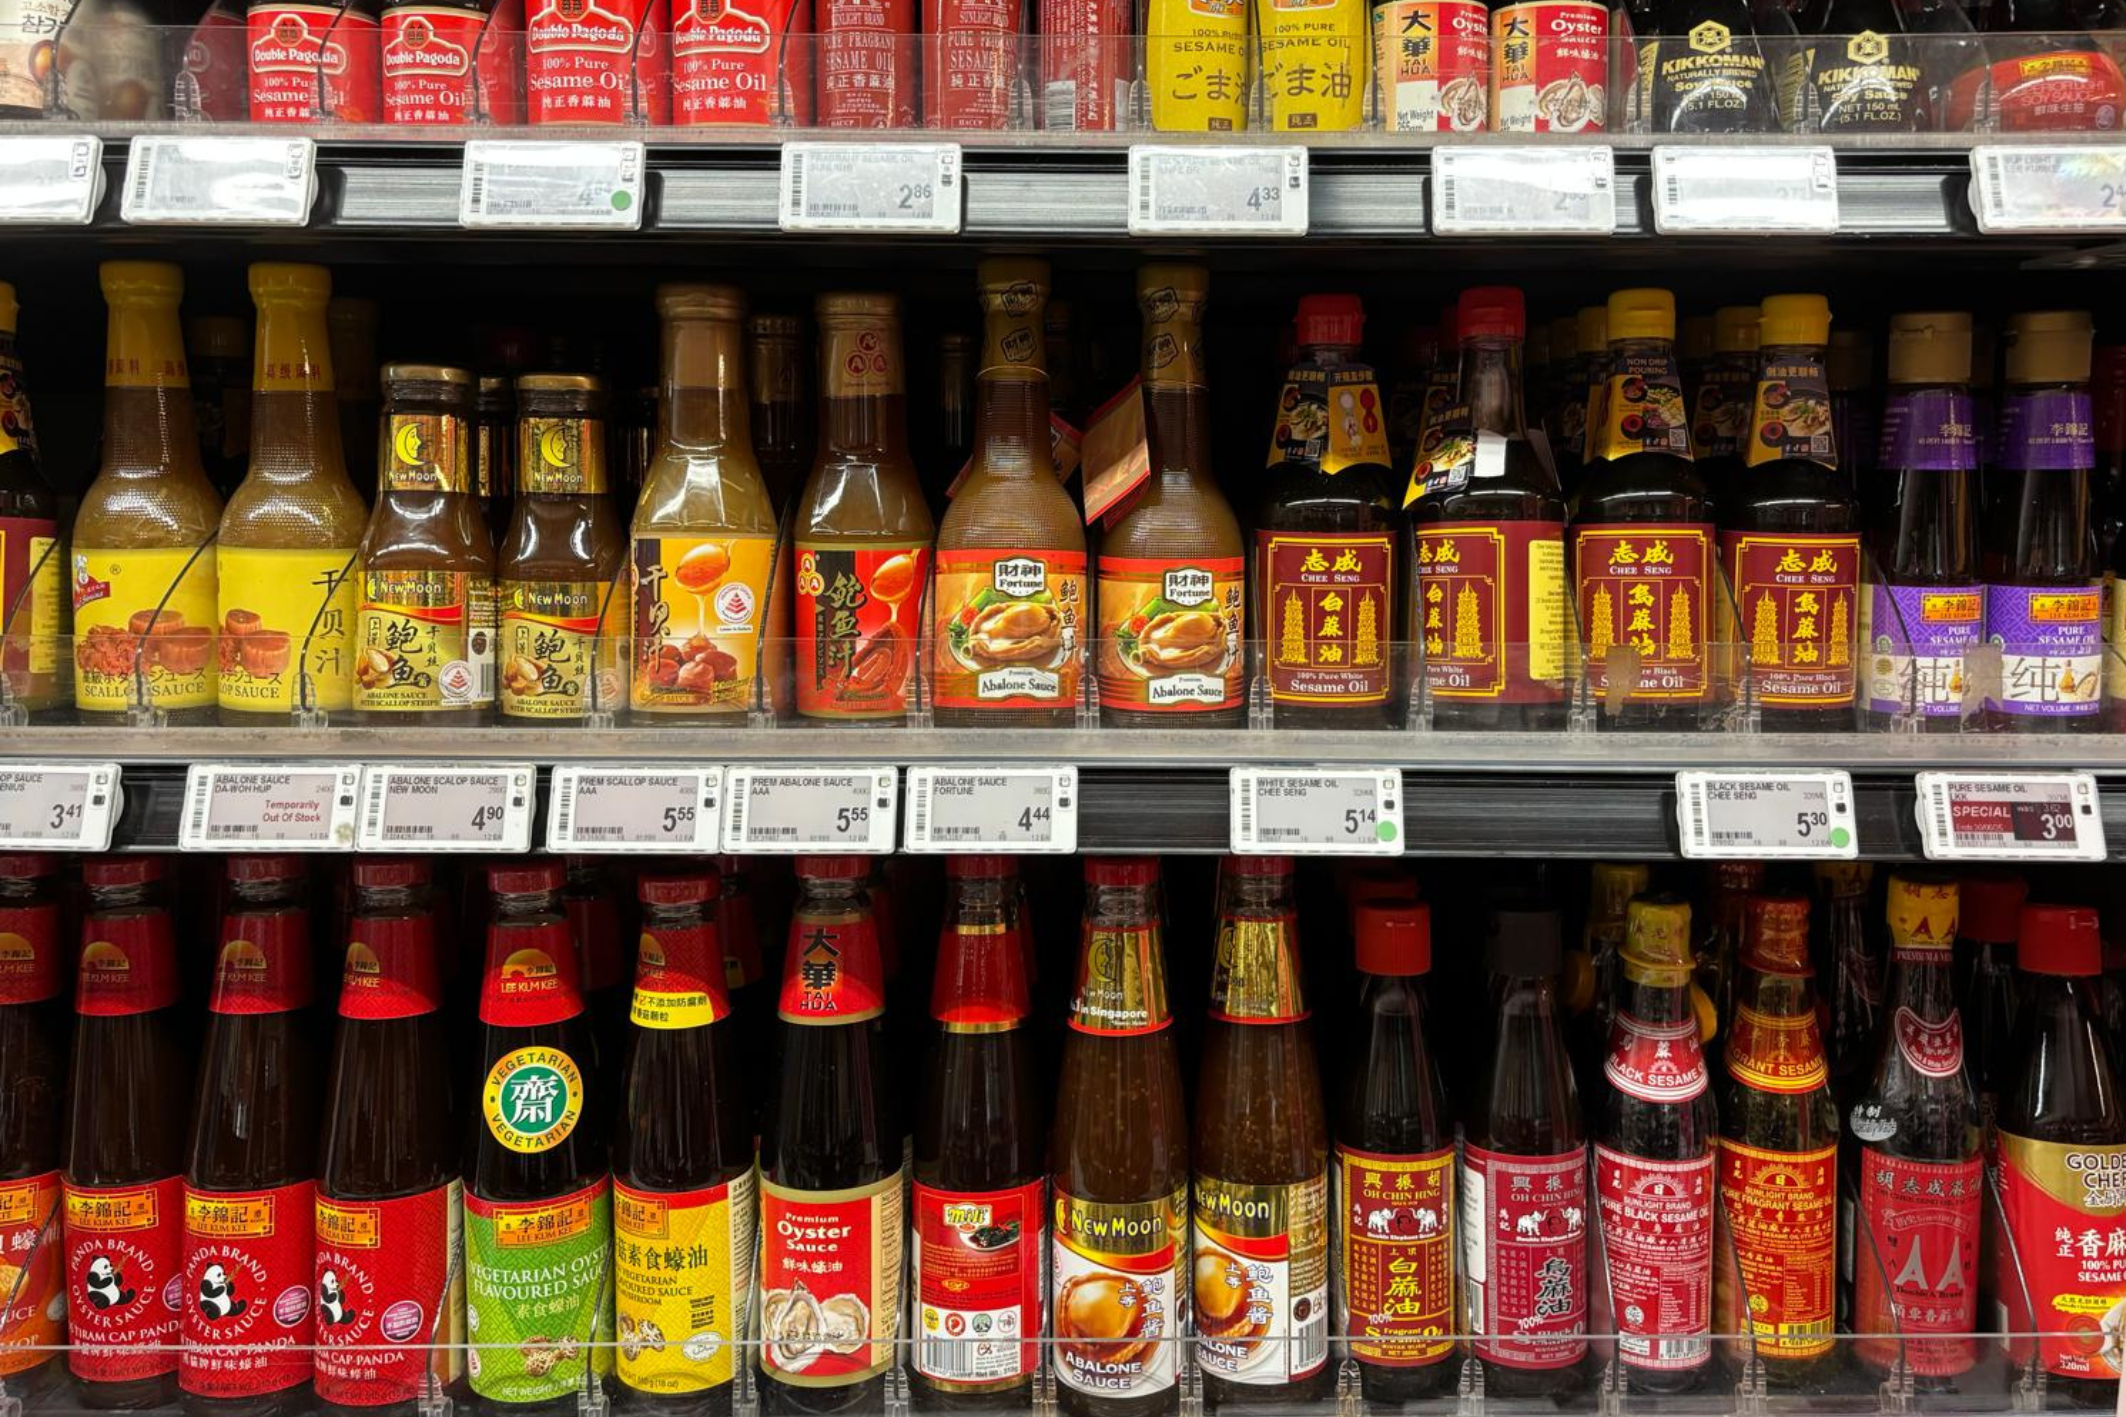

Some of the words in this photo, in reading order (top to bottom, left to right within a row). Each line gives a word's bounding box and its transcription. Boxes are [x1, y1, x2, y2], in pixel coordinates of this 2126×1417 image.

[532, 26, 569, 41] Double
[572, 24, 624, 41] Pagoda
[675, 26, 707, 43] Double
[709, 25, 761, 42] Pagoda
[1274, 23, 1301, 34] 100%
[1303, 22, 1336, 33] PURE
[1550, 19, 1603, 36] Oyster
[1174, 41, 1239, 54] SESAME
[1262, 38, 1322, 52] SESAME
[1327, 37, 1351, 49] OIL
[254, 49, 287, 62] Double
[386, 53, 414, 66] Double
[415, 52, 460, 65] Pagoda
[542, 58, 571, 70] 100%
[575, 57, 608, 69] Pure
[684, 60, 708, 74] 100%
[1403, 59, 1428, 67] TAI
[1661, 54, 1765, 75] KIKKOMAN
[1400, 66, 1432, 77] HUA
[418, 80, 447, 90] Pure
[531, 74, 594, 92] Sesame
[673, 75, 730, 93] Sesame
[736, 72, 767, 92] Oil
[254, 91, 308, 103] Sesame
[385, 94, 435, 105] Sesame
[439, 91, 466, 105] Oil
[1609, 565, 1638, 575] CHEE
[1644, 565, 1672, 575] SENG
[998, 578, 1043, 589] Fortune
[1334, 573, 1361, 583] SENG
[1775, 573, 1805, 584] CHEE
[1810, 574, 1836, 584] SENG
[1169, 588, 1211, 599] Fortune
[1318, 672, 1338, 680] Pure
[1653, 667, 1678, 676] Black
[982, 678, 1027, 692] Abalone
[1028, 679, 1058, 693] Sauce
[1290, 679, 1346, 693] Sesame
[1348, 680, 1369, 693] Oil
[1449, 673, 1470, 688] Oil
[1662, 675, 1685, 689] Oil
[1761, 680, 1819, 694] Sesame
[1822, 681, 1842, 694] Oil
[234, 686, 280, 699] SAUCE
[1152, 686, 1195, 699] Abalone
[1197, 686, 1223, 699] Sauce
[14, 774, 43, 783] SAUCE
[215, 775, 251, 785] ABALONE
[256, 775, 291, 785] SAUCE
[389, 776, 431, 786] ABALONE
[433, 776, 468, 786] SCALOP
[470, 776, 499, 786] SAUCE
[579, 777, 605, 786] PREM
[606, 777, 646, 786] SCALLOP
[648, 777, 678, 786] SAUCE
[779, 778, 822, 787] ABALONE
[823, 778, 854, 787] SAUCE
[934, 777, 976, 787] ABALONE
[978, 777, 1008, 787] SAUCE
[1257, 778, 1286, 788] WHITE
[1288, 778, 1322, 788] SESAME
[1324, 778, 1339, 788] OIL
[389, 786, 410, 795] NEW
[411, 786, 438, 795] MOON
[578, 786, 598, 795] AAA
[752, 787, 770, 796] AAA
[934, 786, 975, 796] FORTUNE
[1257, 787, 1282, 797] CHEE
[1284, 787, 1307, 797] SENG
[1706, 782, 1736, 792] BLACK
[1738, 782, 1775, 792] SESAME
[1776, 783, 1791, 792] OIL
[1948, 784, 1973, 793] PURE
[1975, 783, 2012, 793] SESAME
[2013, 784, 2028, 793] OIL
[1707, 791, 1732, 801] CHEE
[1734, 791, 1758, 801] SENG
[265, 800, 320, 812] Temporarily
[1952, 805, 2012, 818] SPECIAL
[262, 813, 281, 823] Out
[282, 813, 295, 823] Of
[295, 813, 321, 823] Stock
[501, 980, 517, 993] LEE
[518, 980, 540, 993] KUM
[541, 978, 558, 992] KEE
[804, 992, 832, 1001] TAI
[800, 1000, 837, 1011] HUA
[1090, 1007, 1148, 1020] Singapore
[491, 1052, 577, 1087] VEGETARIAN
[1647, 1067, 1698, 1087] SESAME
[491, 1108, 577, 1148] VEGETARIAN
[1363, 1188, 1380, 1199] OH
[1382, 1191, 1412, 1201] CHIN
[1511, 1192, 1530, 1203] OH
[1532, 1192, 1561, 1204] CHIN
[785, 1212, 840, 1224] Premium
[1624, 1206, 1659, 1223] BLACK
[1661, 1211, 1699, 1223] SESAME
[776, 1219, 852, 1241] Oyster
[786, 1239, 839, 1253] Sauce
[72, 1239, 104, 1271] PANDA
[107, 1239, 155, 1273] BRAND
[186, 1246, 218, 1279] PANDA
[221, 1245, 267, 1283] BRAND
[2081, 1260, 2111, 1271] 100%
[334, 1252, 375, 1296] BRAND
[471, 1260, 566, 1284] VEGETARIAN
[2078, 1271, 2122, 1283] SESAME
[473, 1277, 567, 1301] FLAVOURED
[657, 1286, 694, 1298] SAUCE
[71, 1284, 112, 1328] OYSTER
[114, 1284, 156, 1326] SAUCE
[185, 1293, 222, 1340] OYSTER
[224, 1296, 267, 1339] SAUCE
[337, 1309, 375, 1347] SAUCE
[108, 1331, 136, 1343] CAP
[330, 1351, 355, 1366] CAP
[356, 1351, 404, 1366] PANDA
[1064, 1350, 1143, 1374] ABALONE
[1072, 1371, 1132, 1390] SAUCE
